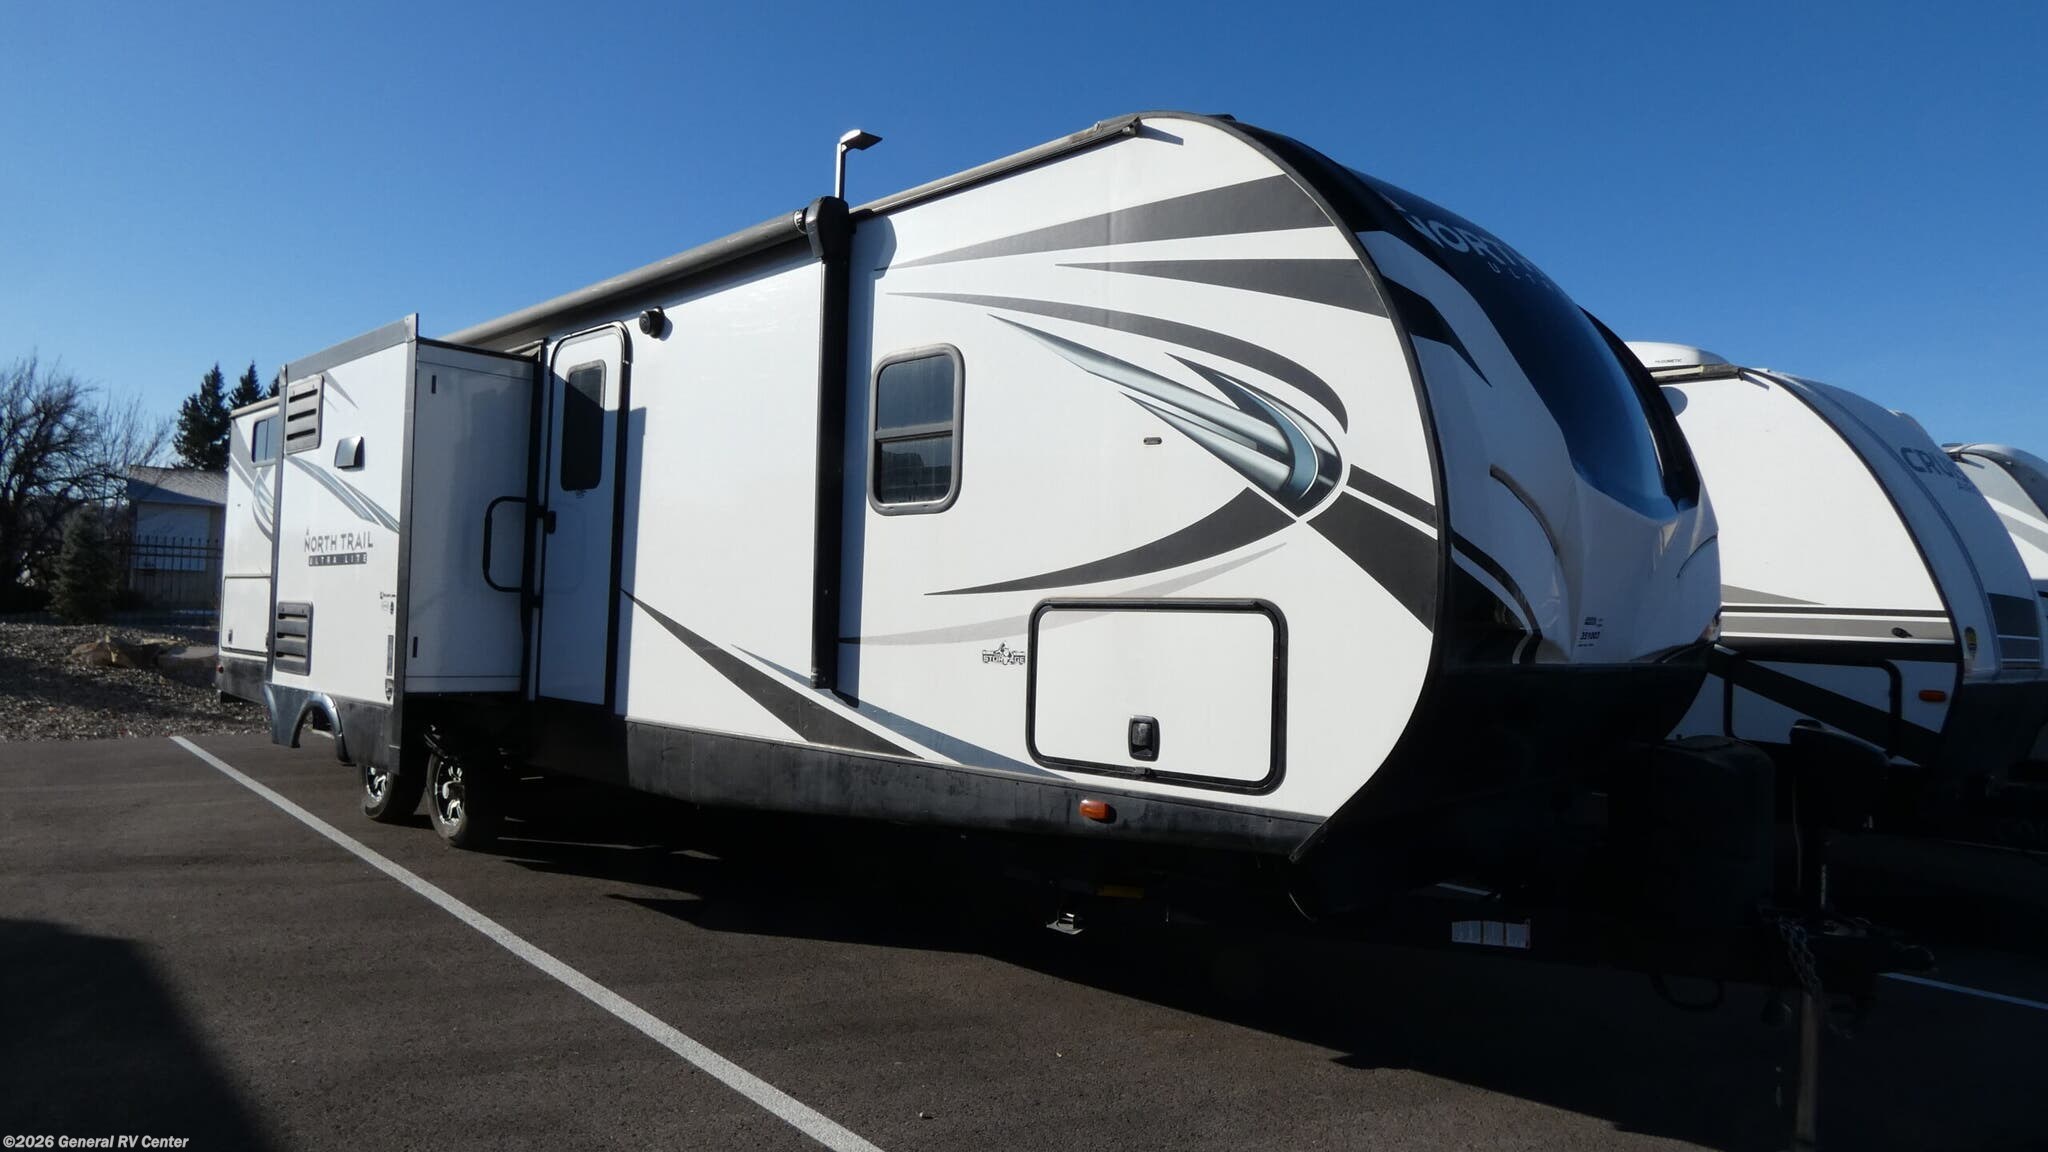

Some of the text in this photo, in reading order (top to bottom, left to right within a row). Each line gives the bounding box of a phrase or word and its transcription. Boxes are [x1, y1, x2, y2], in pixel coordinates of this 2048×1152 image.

[304, 531, 374, 553] NORTH TRAIL
[345, 553, 367, 563] LITE
